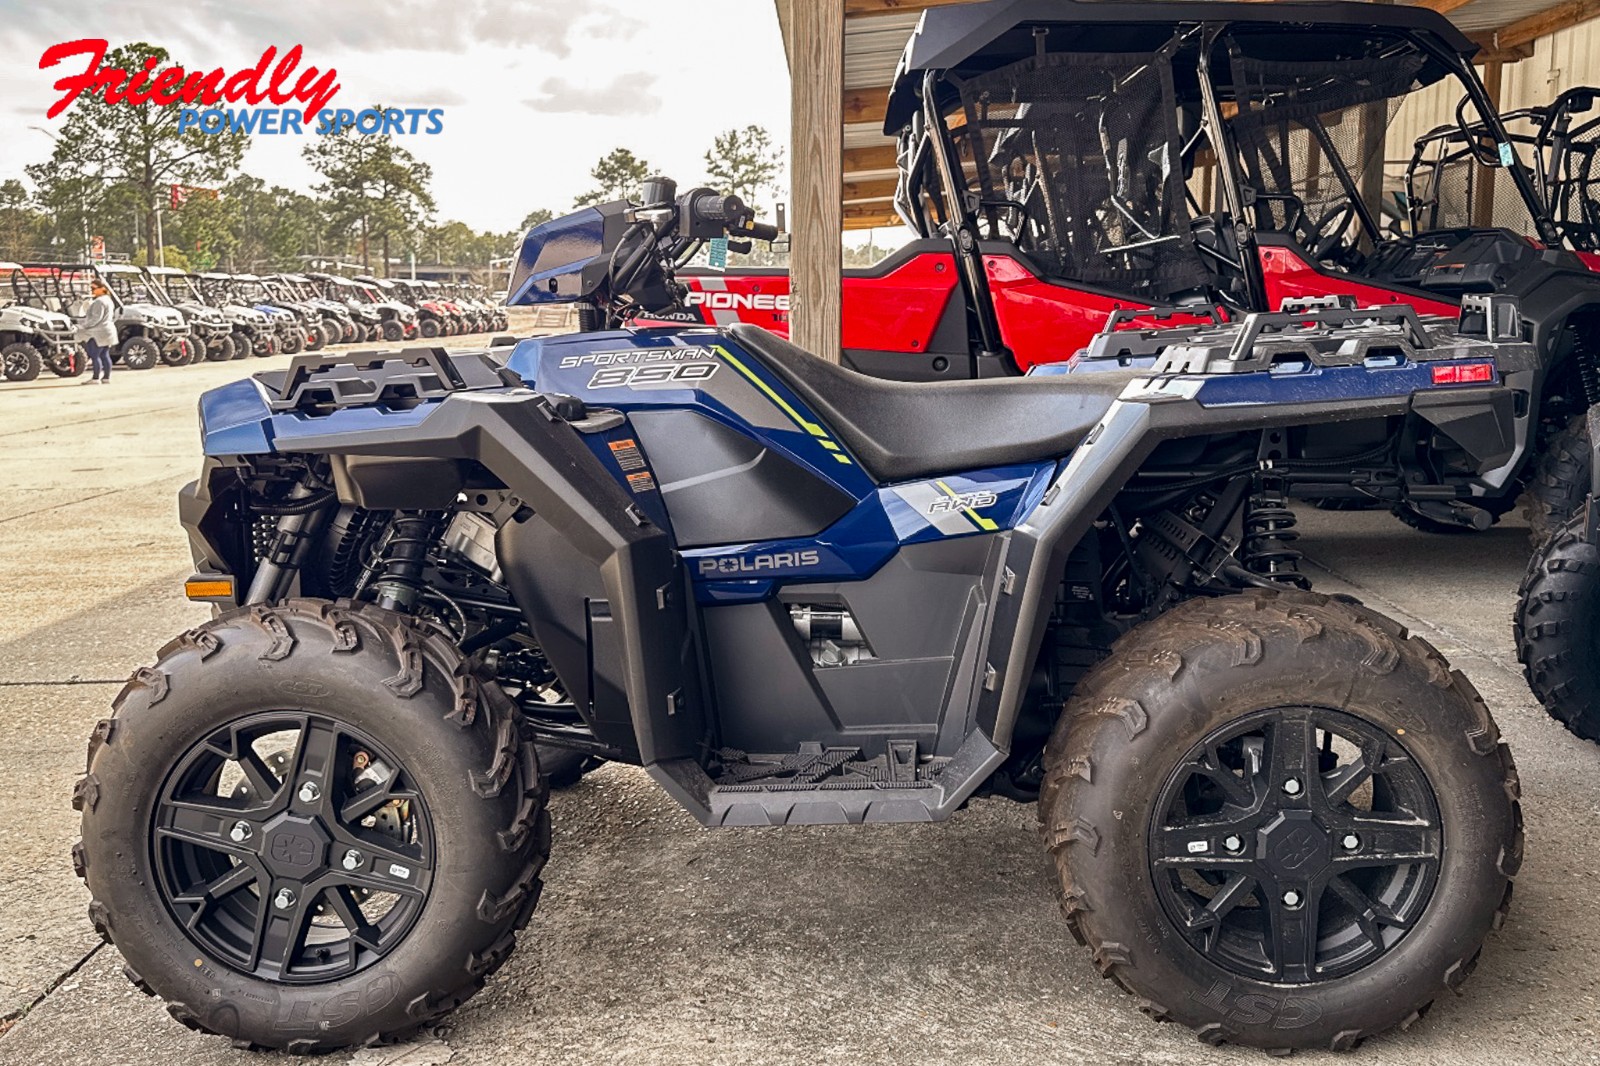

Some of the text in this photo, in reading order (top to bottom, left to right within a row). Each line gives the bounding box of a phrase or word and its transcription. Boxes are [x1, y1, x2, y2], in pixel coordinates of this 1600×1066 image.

[559, 348, 718, 369] SPORTSMAN
[587, 362, 721, 390] 850
[926, 490, 998, 515] AWD
[698, 550, 819, 575] POLARIS
